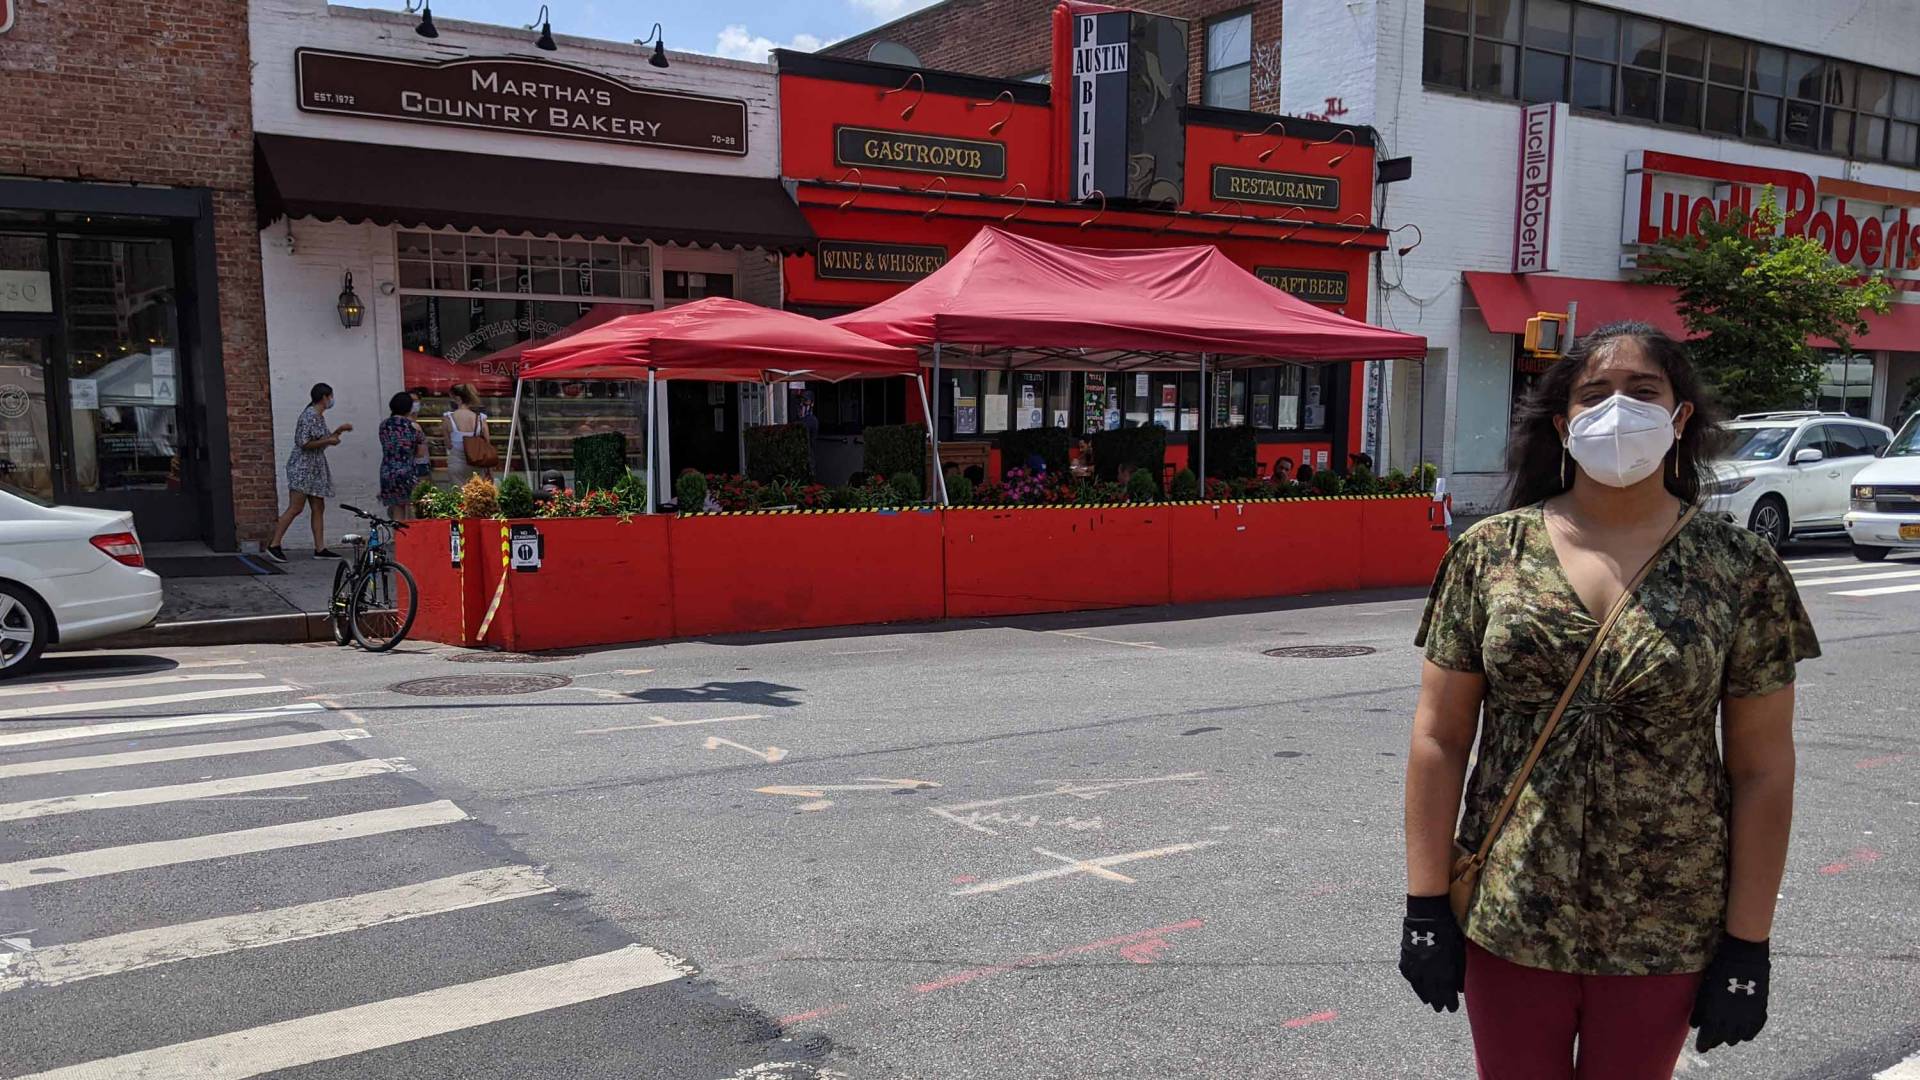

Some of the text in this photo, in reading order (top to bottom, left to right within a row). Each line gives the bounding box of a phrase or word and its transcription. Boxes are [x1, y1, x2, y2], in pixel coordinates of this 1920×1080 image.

[1076, 44, 1126, 74] AUSTIN
[313, 92, 355, 105] EST. 1972
[471, 69, 611, 106] MARTHA'S
[401, 91, 662, 137] COUNTRY BAKERY
[1082, 18, 1094, 196] PUBLIC
[711, 135, 736, 145] 70-28
[864, 139, 982, 169] GASTROPUB
[1526, 110, 1548, 180] Lucille
[1230, 176, 1325, 200] RESTAURANT
[1521, 182, 1549, 267] Roberts
[823, 250, 862, 270] WINE
[865, 252, 875, 270] &
[1309, 278, 1344, 295] BEER
[444, 319, 531, 366] MARTHA'S
[159, 382, 171, 397] A
